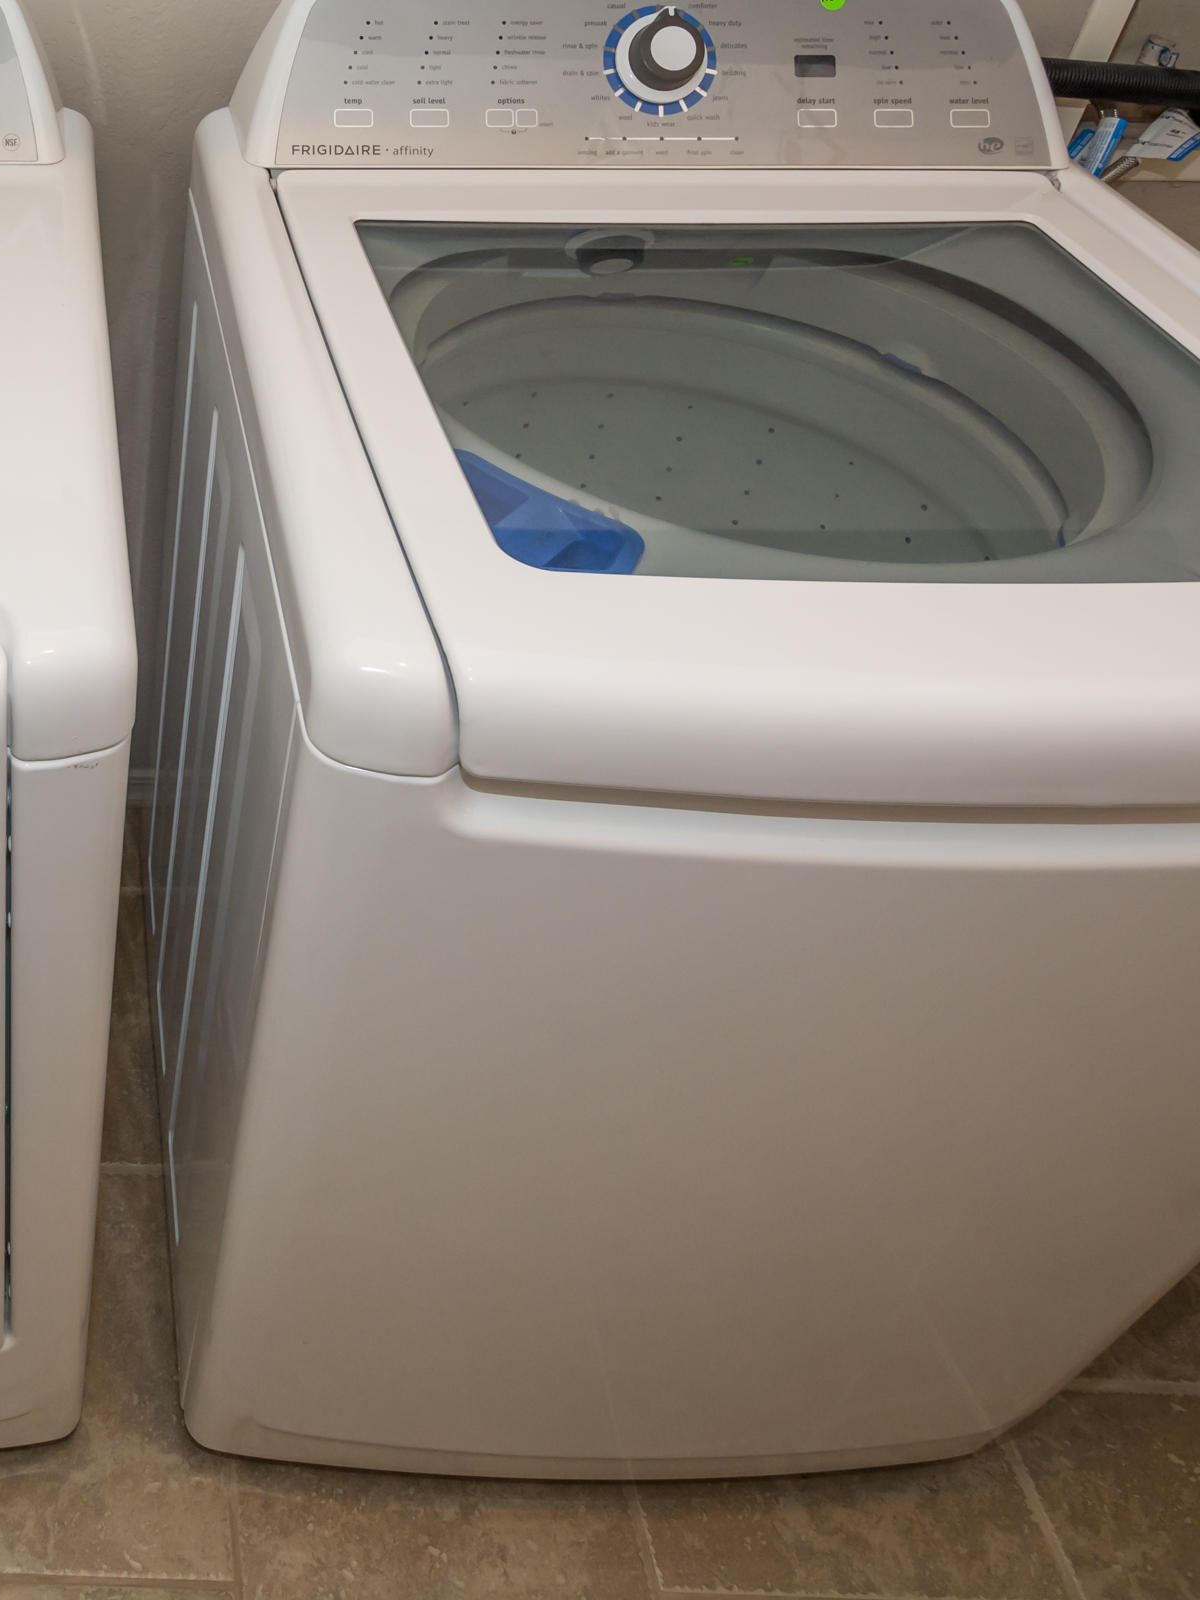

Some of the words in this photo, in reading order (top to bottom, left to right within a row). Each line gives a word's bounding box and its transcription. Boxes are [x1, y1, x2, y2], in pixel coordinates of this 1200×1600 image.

[708, 19, 726, 27] heavy
[727, 19, 742, 28] duty
[437, 34, 453, 42] heavy
[343, 97, 362, 105] temp
[412, 97, 426, 105] soil
[428, 97, 446, 105] level
[497, 97, 525, 106] options
[712, 95, 729, 103] jeans
[796, 97, 817, 106] delay
[818, 97, 836, 105] start
[873, 97, 890, 106] spin
[891, 97, 912, 106] speed
[949, 97, 970, 105] water
[971, 97, 989, 105] level
[686, 113, 704, 121] quick
[705, 113, 721, 121] wash
[646, 120, 659, 128] kids
[4, 137, 18, 147] NSF
[291, 144, 381, 156] FRIGIDAIRE
[393, 145, 434, 158] affinity
